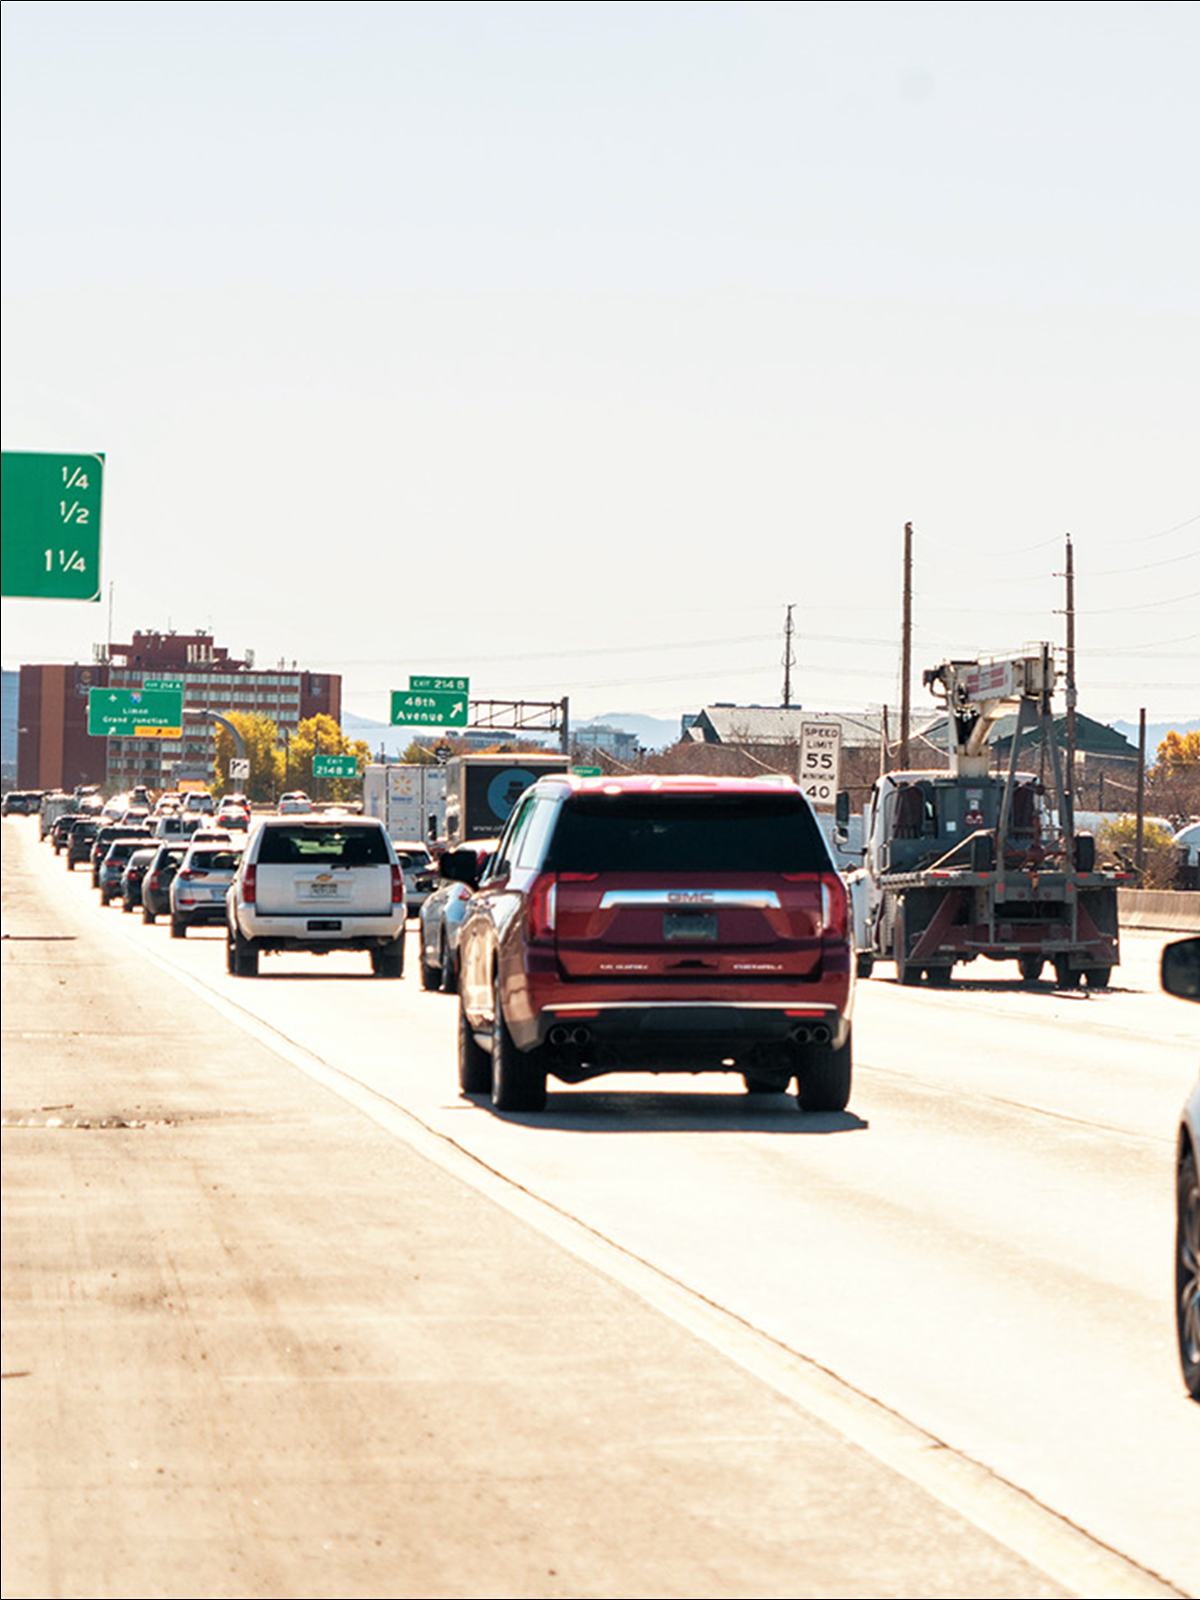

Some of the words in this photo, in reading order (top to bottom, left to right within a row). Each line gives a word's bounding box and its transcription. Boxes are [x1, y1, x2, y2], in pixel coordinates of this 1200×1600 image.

[405, 697, 436, 707] 48th
[132, 716, 168, 724] Junction
[396, 711, 443, 722] Avenue
[804, 728, 838, 738] SPEED
[807, 740, 833, 749] LIMIT
[806, 753, 833, 769] 55
[806, 785, 830, 799] 40
[667, 892, 714, 903] GMC
